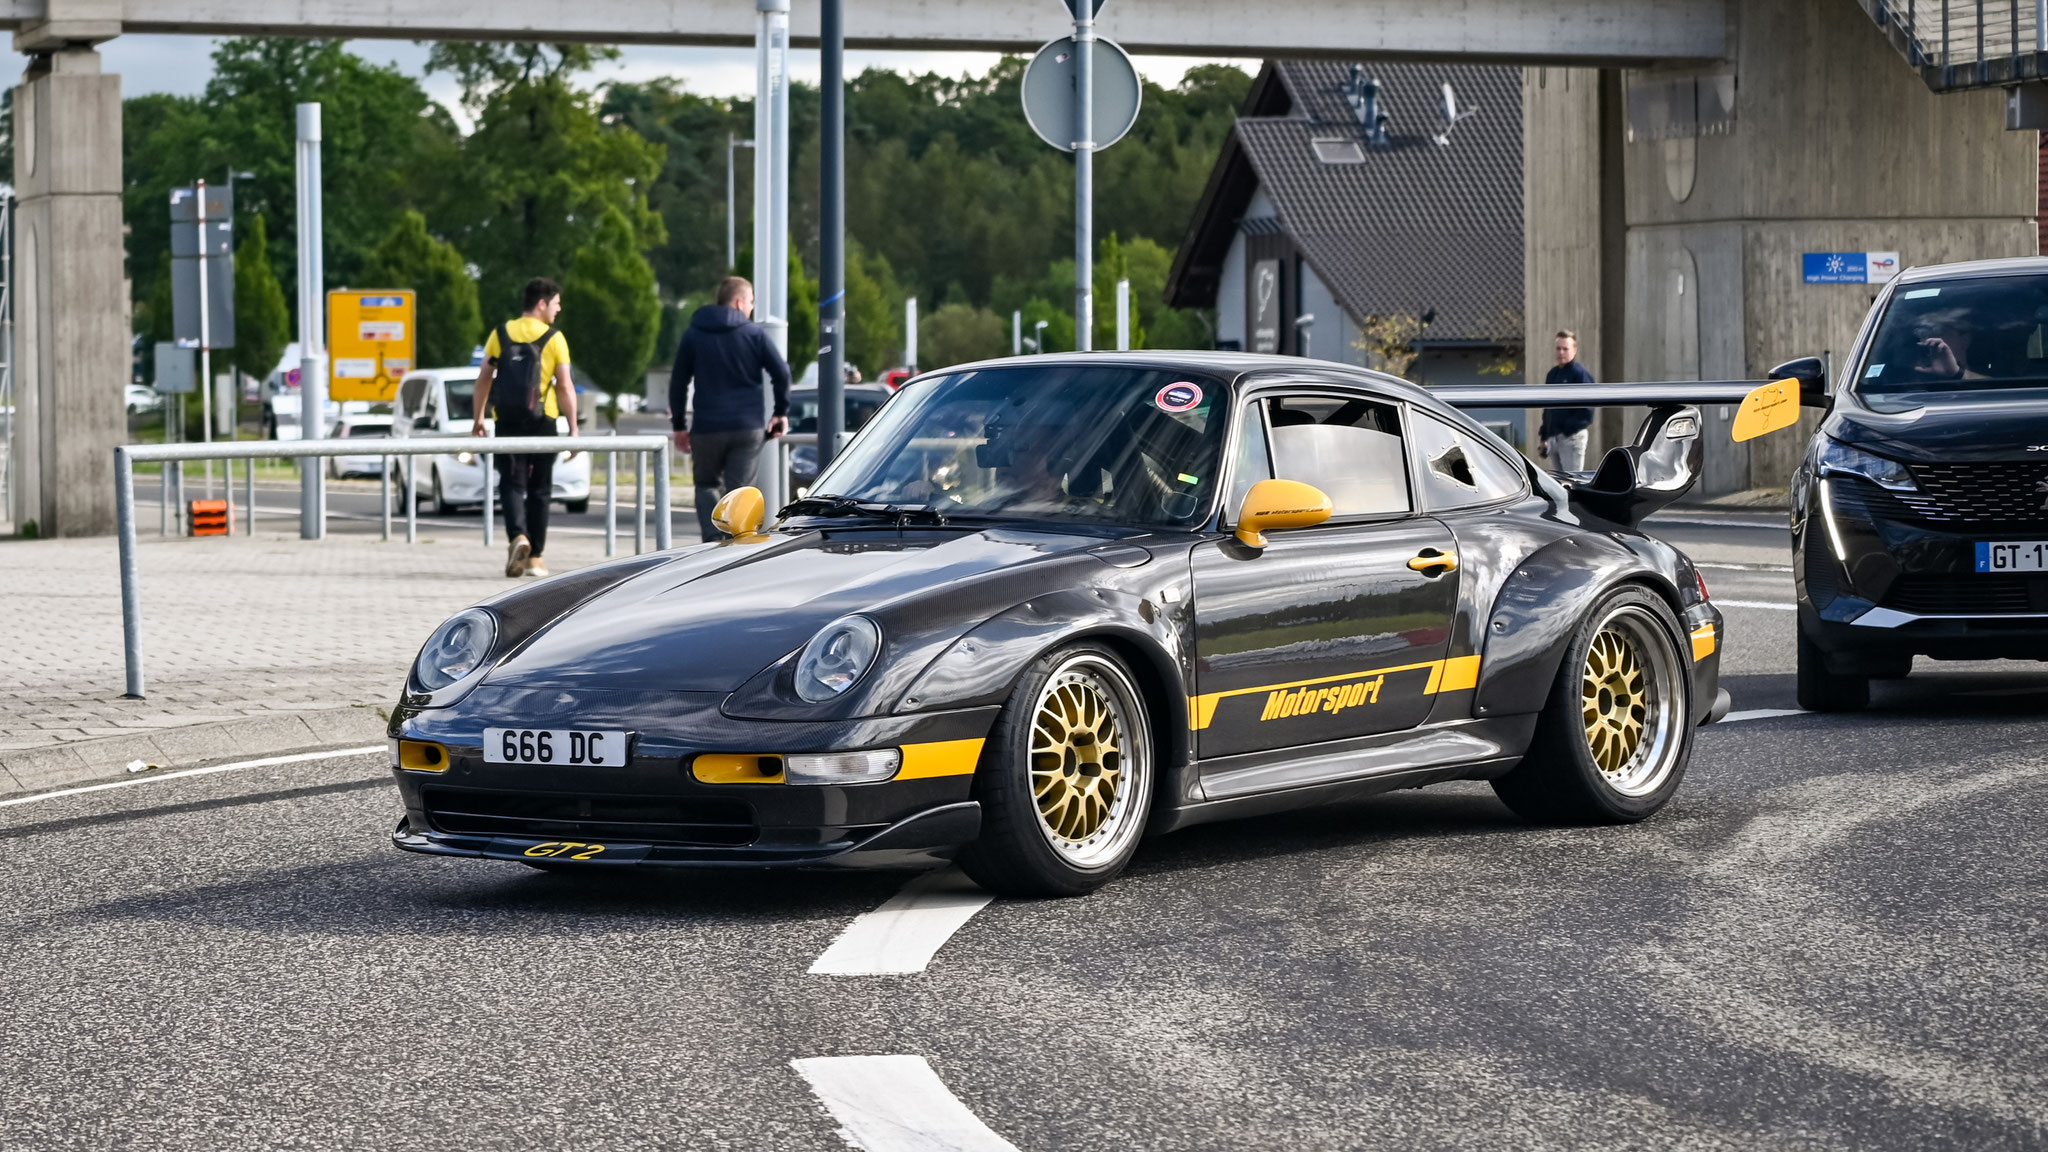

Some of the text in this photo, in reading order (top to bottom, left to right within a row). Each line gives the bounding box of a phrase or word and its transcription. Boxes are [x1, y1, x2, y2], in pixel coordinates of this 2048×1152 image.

[1993, 544, 2048, 568] GT-1
[1260, 674, 1384, 722] Motorsport
[503, 729, 604, 764] 666 DC
